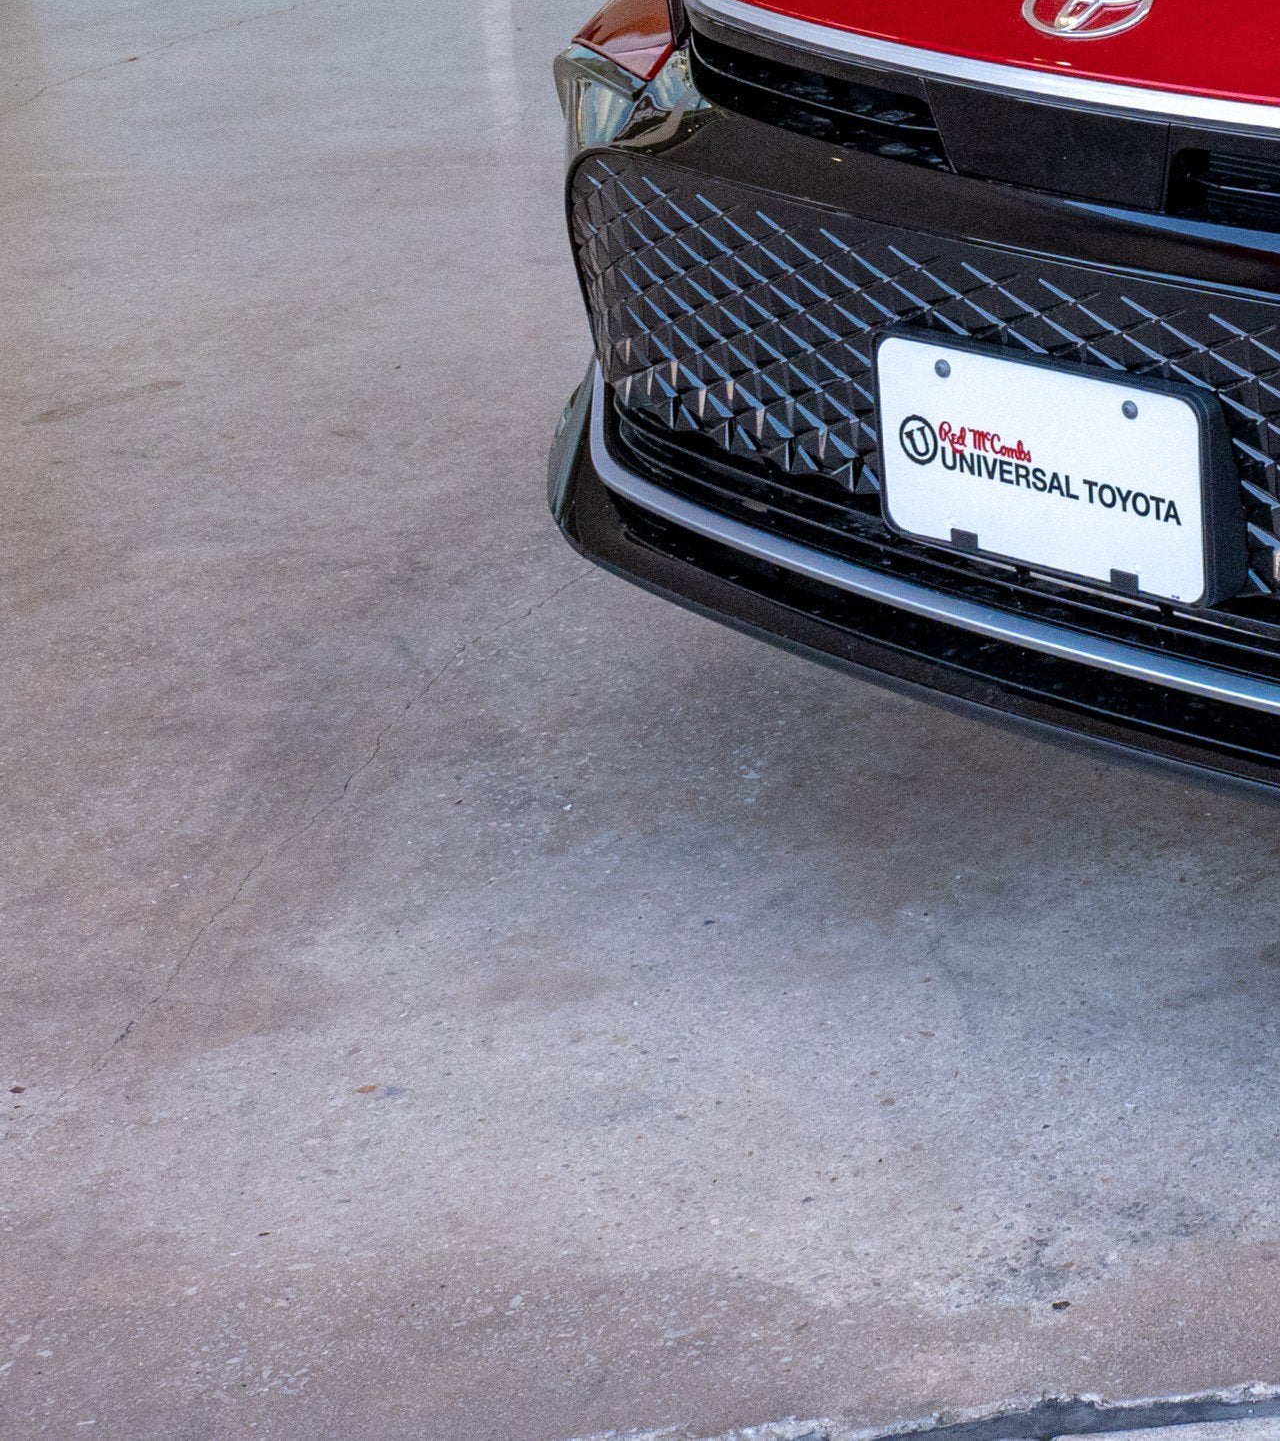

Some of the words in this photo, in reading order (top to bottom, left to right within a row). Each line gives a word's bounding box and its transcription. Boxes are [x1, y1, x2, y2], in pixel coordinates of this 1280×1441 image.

[938, 420, 968, 454] Red
[967, 427, 1032, 463] McCombs
[940, 446, 1080, 501] UNIVERSAL
[1082, 478, 1182, 526] TOYOTA
